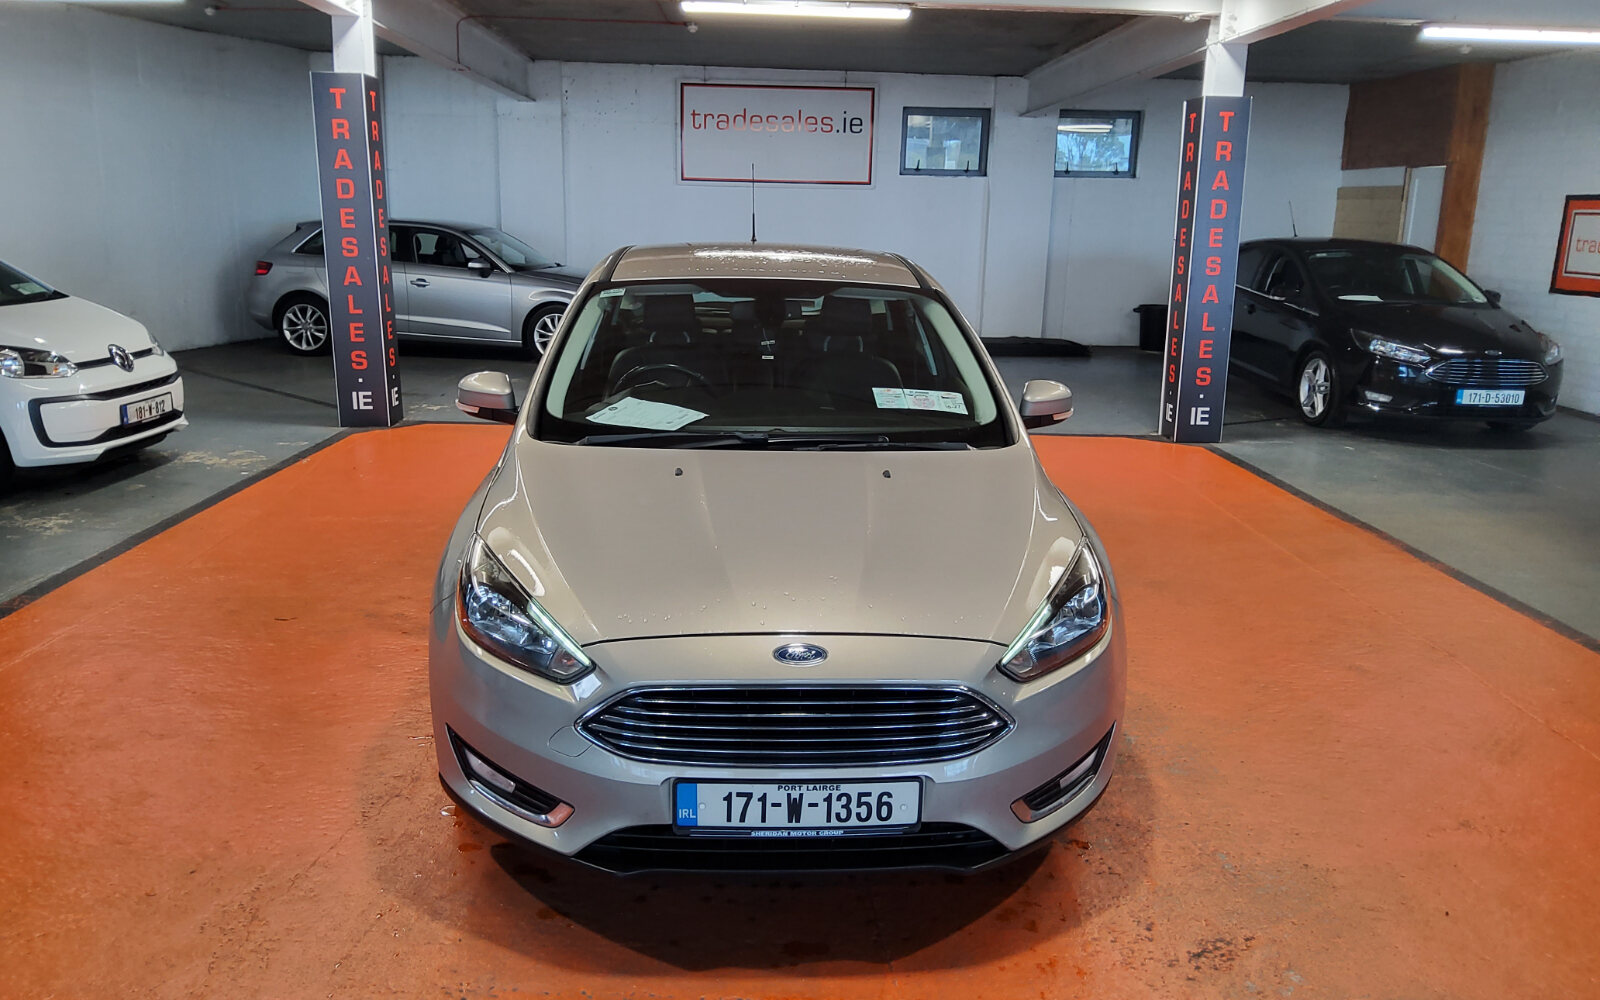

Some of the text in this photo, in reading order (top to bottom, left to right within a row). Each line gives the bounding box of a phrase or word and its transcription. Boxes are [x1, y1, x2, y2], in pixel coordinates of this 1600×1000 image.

[690, 107, 864, 134] tradesales.ie
[1576, 238, 1600, 254] tra
[1468, 391, 1521, 404] 171-D-53010
[135, 399, 166, 420] 181-W-812
[678, 808, 697, 819] IRL
[722, 791, 893, 823] 171-W-1356
